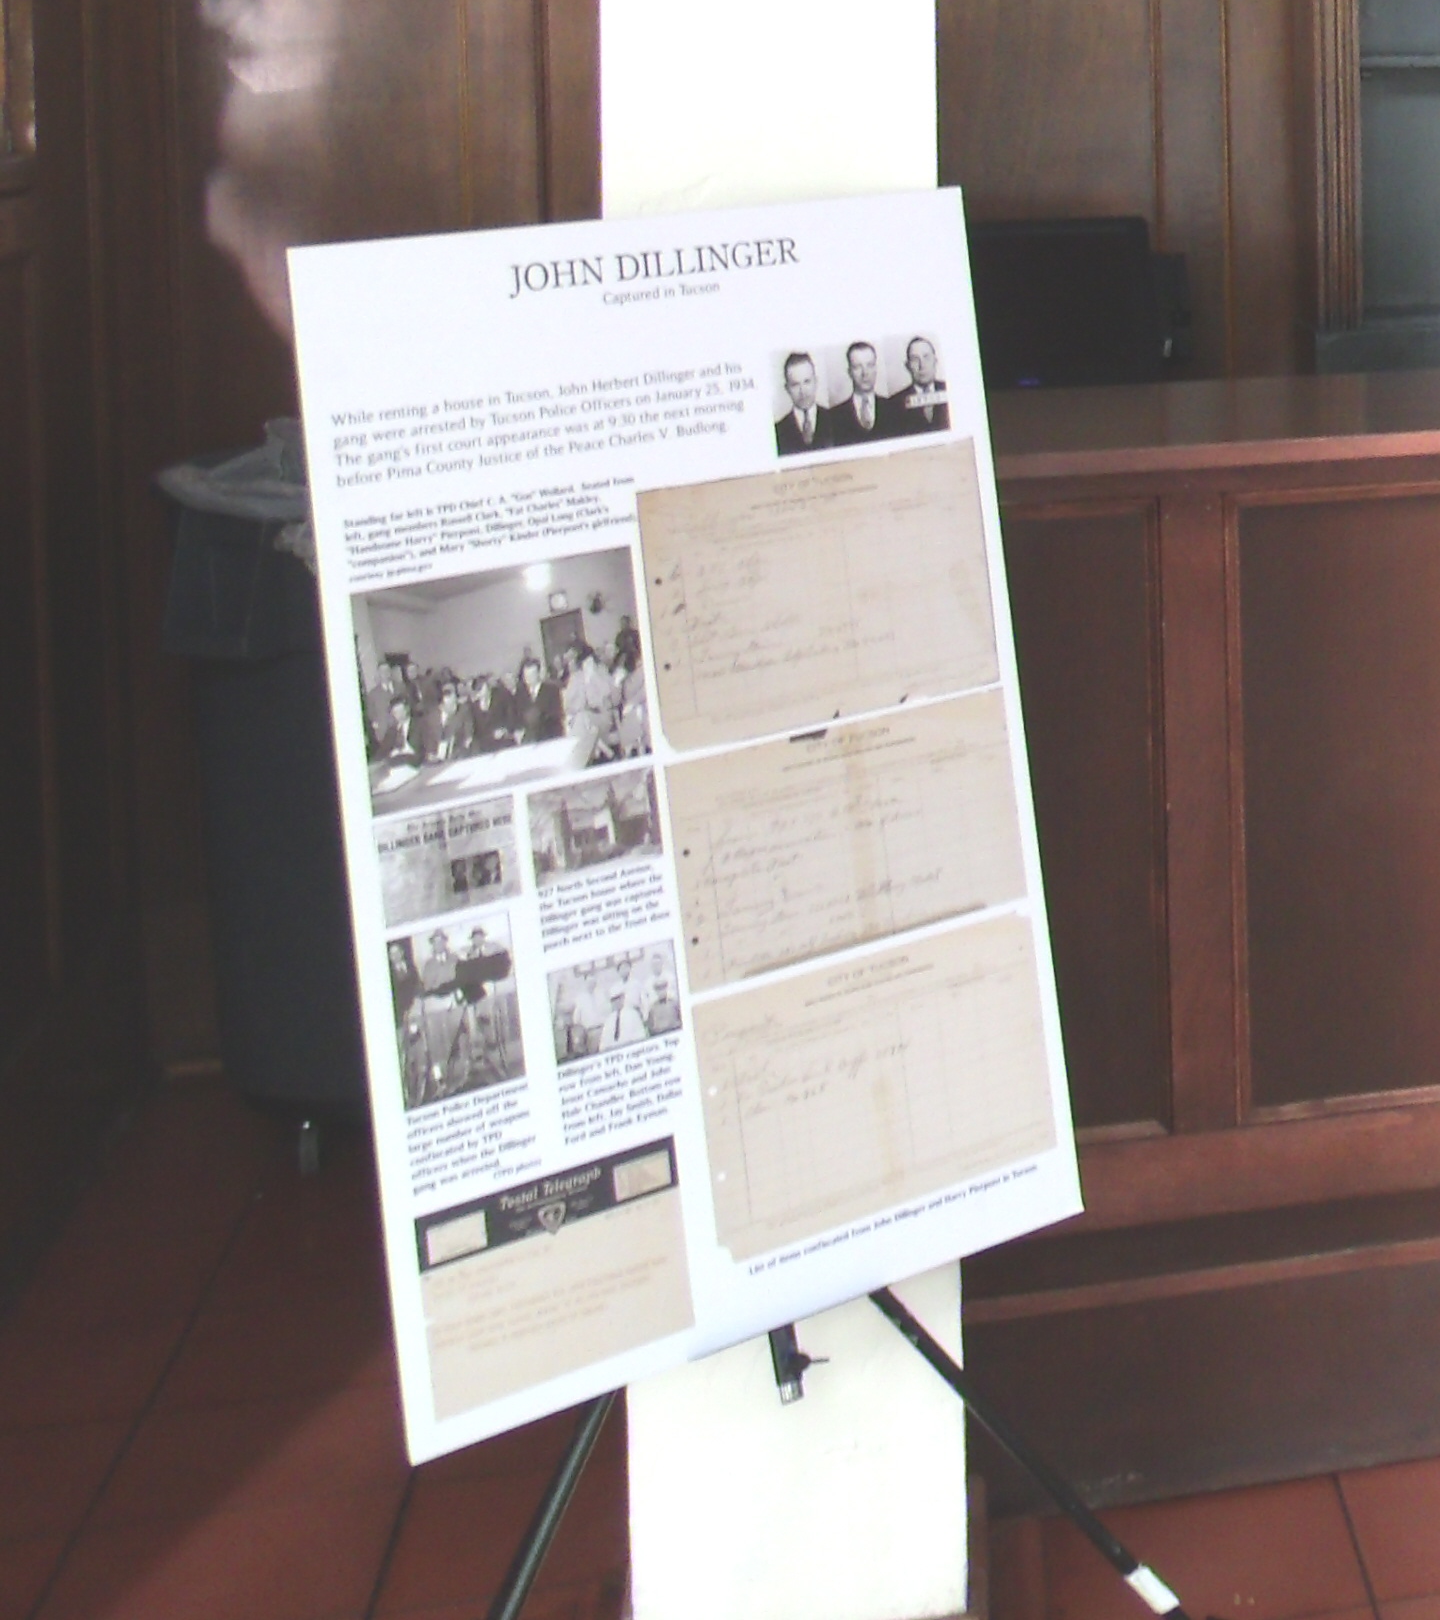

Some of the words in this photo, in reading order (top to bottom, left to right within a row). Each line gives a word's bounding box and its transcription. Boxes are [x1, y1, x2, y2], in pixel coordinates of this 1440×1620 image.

[509, 255, 604, 299] JOHN
[614, 237, 800, 282] DILLINGER
[602, 287, 661, 306] Captured
[663, 285, 676, 298] in
[678, 281, 721, 299] Tucson
[331, 410, 375, 427] While
[378, 404, 428, 421] renting
[431, 404, 440, 415] a
[443, 396, 484, 413] house
[488, 394, 501, 407] in
[558, 381, 588, 397] John
[591, 374, 640, 392] Herbert
[643, 367, 696, 386] Dillinger
[699, 363, 722, 378] and
[724, 361, 743, 376] his
[333, 433, 368, 452] gang
[372, 428, 406, 443] were
[409, 418, 466, 436] arrested
[470, 414, 486, 430] by
[490, 409, 536, 426] Tucson
[539, 402, 577, 419] Police
[580, 394, 632, 413] Officers
[635, 393, 652, 405] on
[655, 386, 702, 403] January
[335, 451, 362, 467] The
[366, 447, 411, 466] gang's
[414, 441, 444, 456] first
[447, 437, 483, 452] court
[486, 424, 561, 448] appearance
[564, 419, 590, 434] was
[593, 417, 605, 431] at
[639, 409, 660, 424] the
[663, 406, 691, 420] next
[694, 398, 745, 416] morning
[336, 468, 383, 488] before
[387, 464, 423, 481] Pima
[426, 456, 474, 475] County
[478, 450, 523, 468] Justice
[525, 446, 540, 461] of
[543, 442, 565, 457] the
[568, 438, 606, 455] Peace
[608, 429, 656, 448] Charles
[500, 1184, 539, 1212] Postal
[542, 1166, 603, 1196] Telegraph
